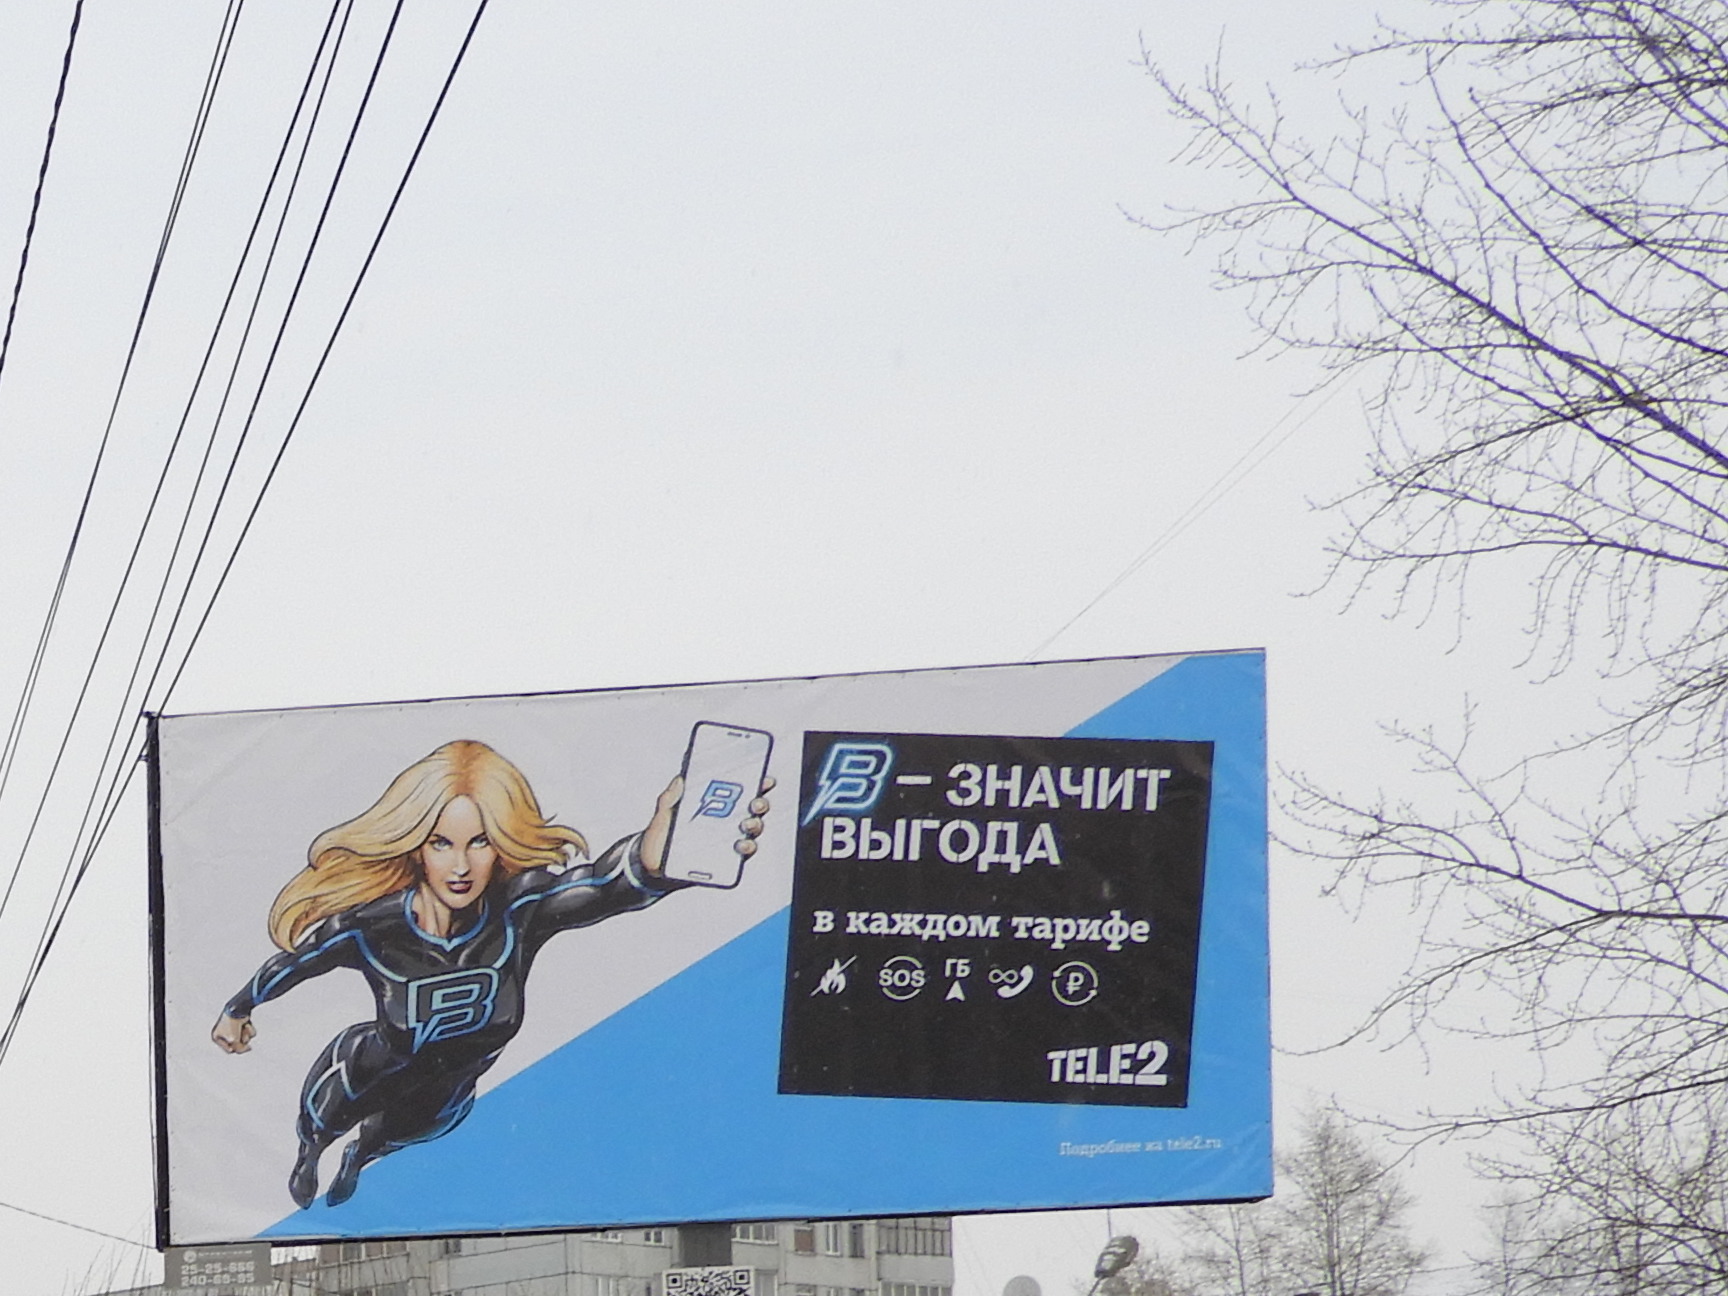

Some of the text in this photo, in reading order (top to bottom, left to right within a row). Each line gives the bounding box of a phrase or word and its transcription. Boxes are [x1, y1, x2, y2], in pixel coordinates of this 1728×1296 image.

[946, 762, 1172, 812] ЗНАЧИТ
[819, 815, 1062, 874] ВЫГОДА
[812, 910, 1152, 950] в каждом тарифе
[878, 968, 926, 988] SOS
[944, 957, 972, 978] ГБ
[1046, 1039, 1170, 1087] TELE2
[1059, 1140, 1141, 1157] Подробнее
